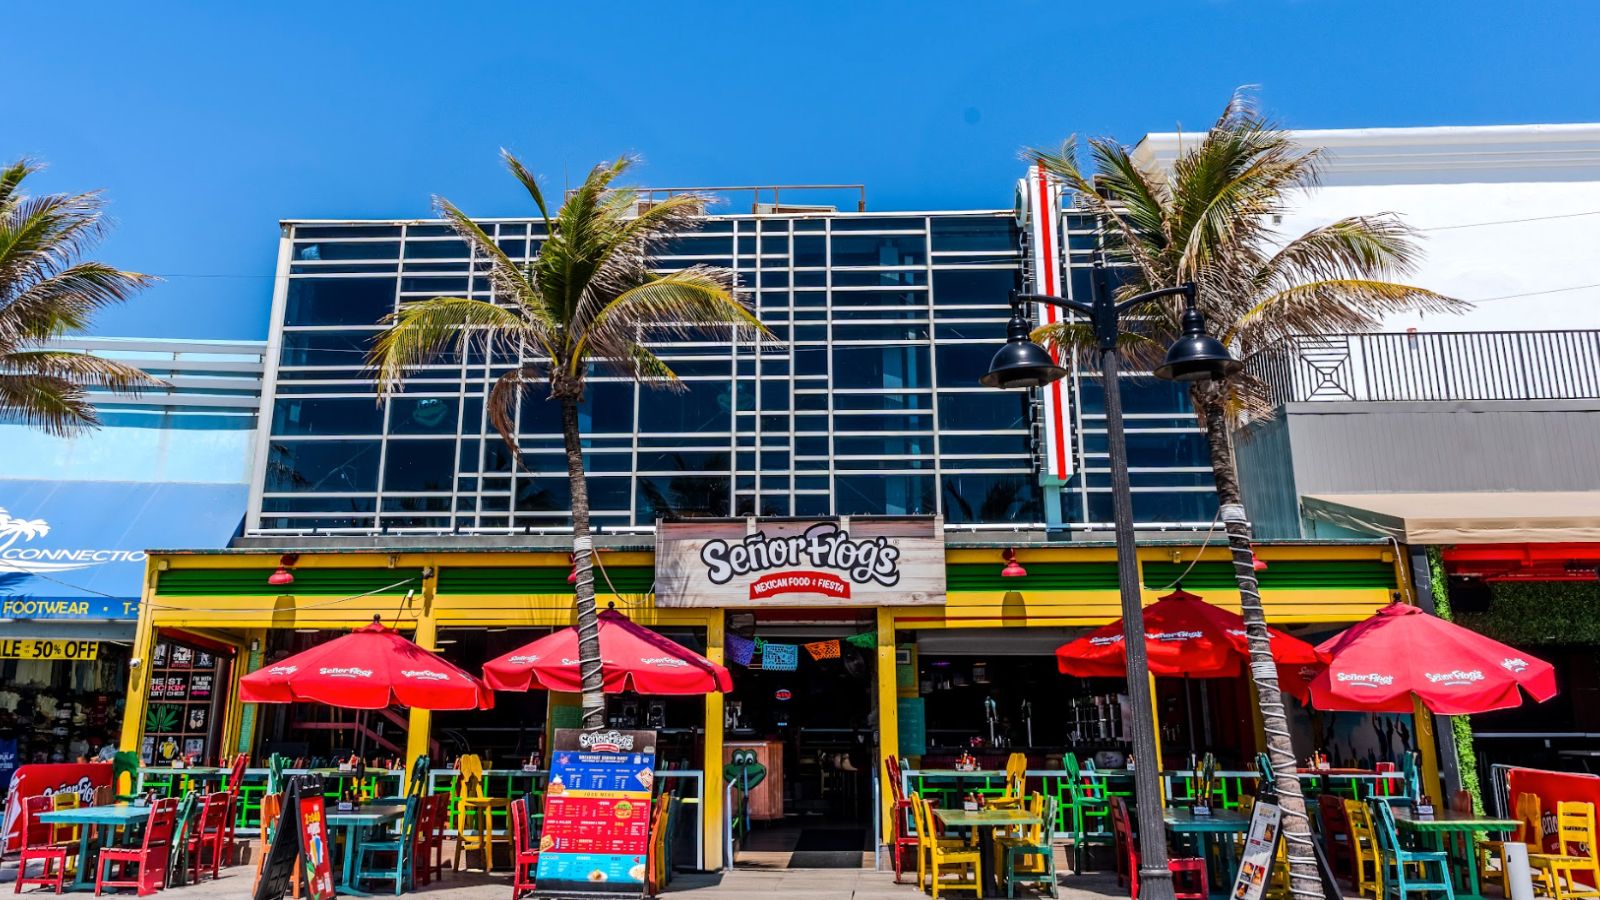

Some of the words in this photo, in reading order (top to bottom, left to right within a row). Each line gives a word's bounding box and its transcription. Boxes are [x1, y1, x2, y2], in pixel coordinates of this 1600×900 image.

[701, 530, 806, 584] Señor
[804, 522, 900, 586] Frog's
[754, 577, 788, 594] MEXICAN
[788, 577, 810, 587] FOOD
[818, 579, 845, 593] FIESTA
[2, 601, 89, 614] FOOTWEAR
[0, 640, 21, 657] LE
[32, 641, 61, 658] 50%
[64, 640, 98, 658] OFF
